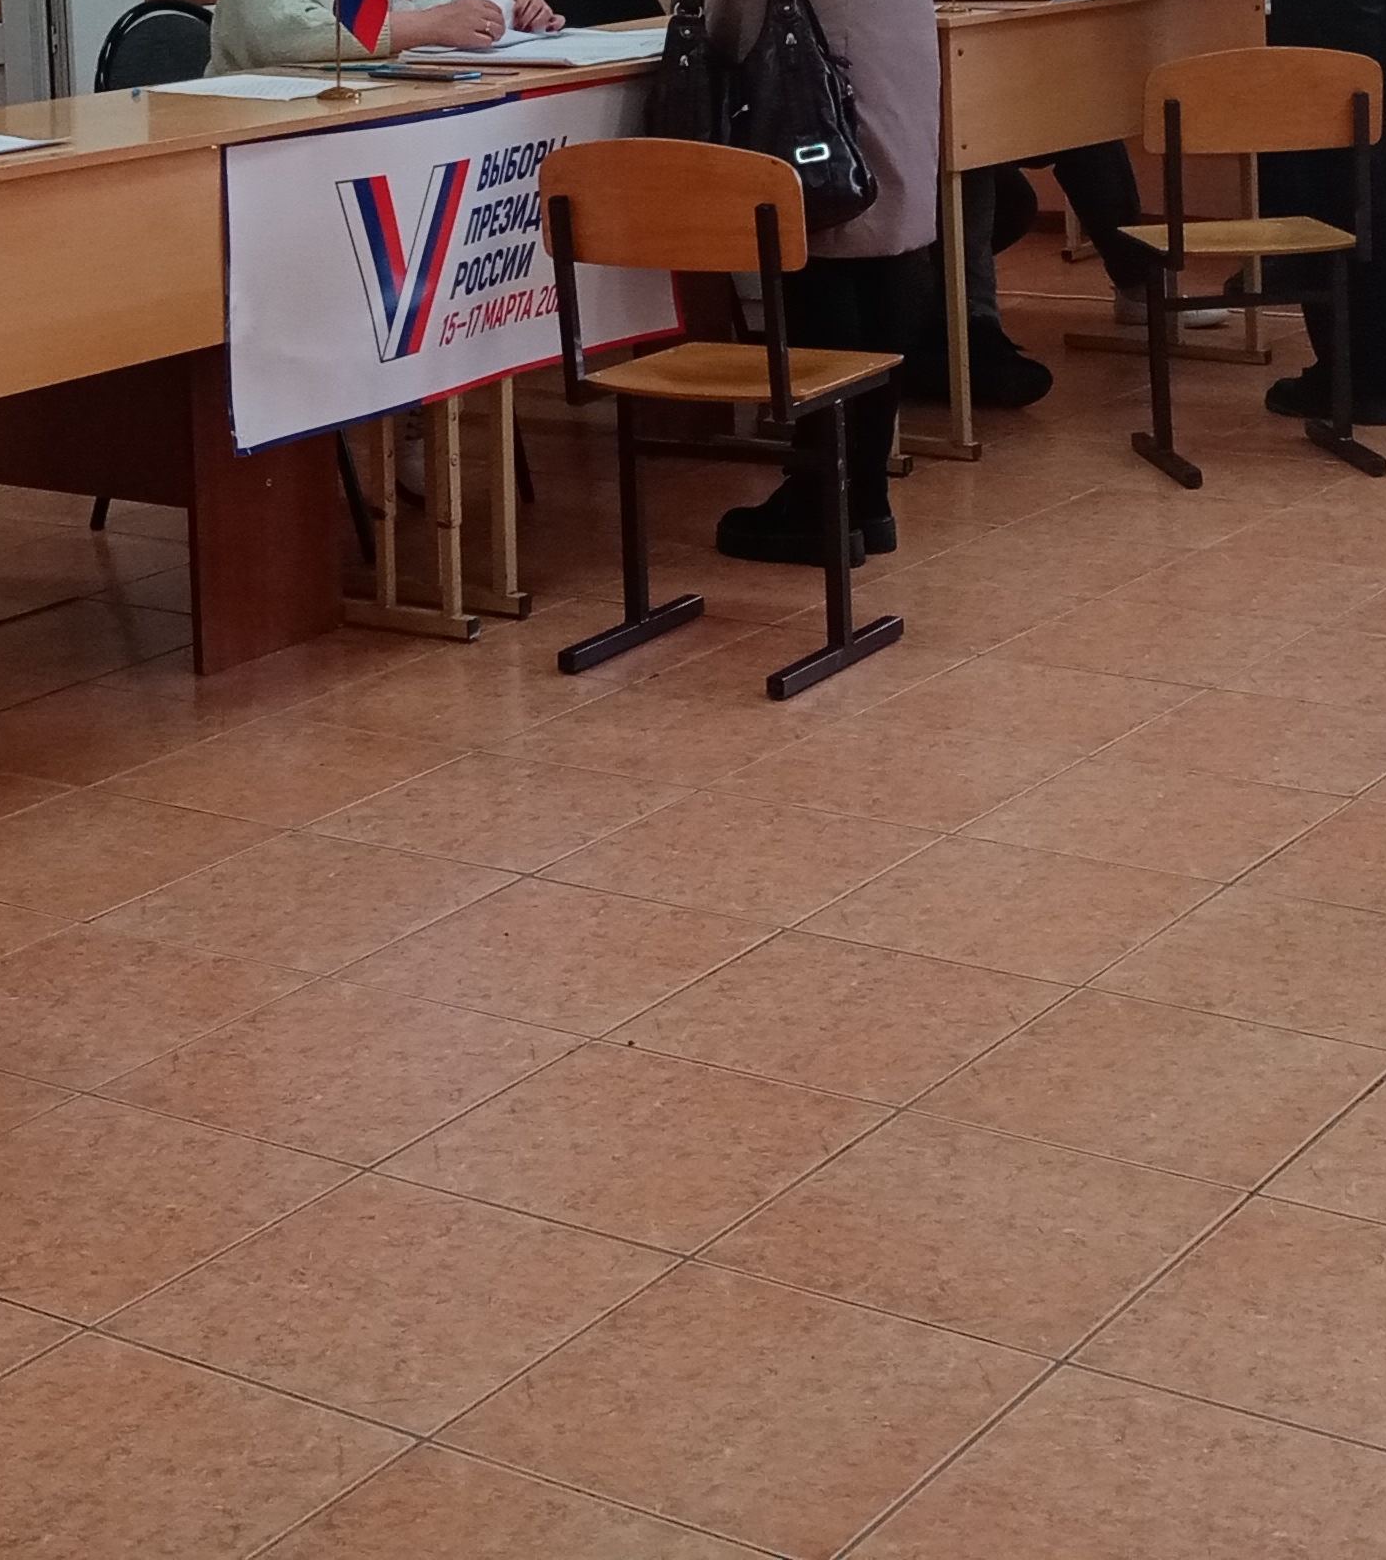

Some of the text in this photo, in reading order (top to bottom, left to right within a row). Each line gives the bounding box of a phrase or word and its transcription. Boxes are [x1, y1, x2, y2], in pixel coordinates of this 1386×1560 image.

[476, 136, 567, 192] ВЫБОР
[449, 241, 536, 300] РОССИИ
[480, 289, 534, 330] МАРТА
